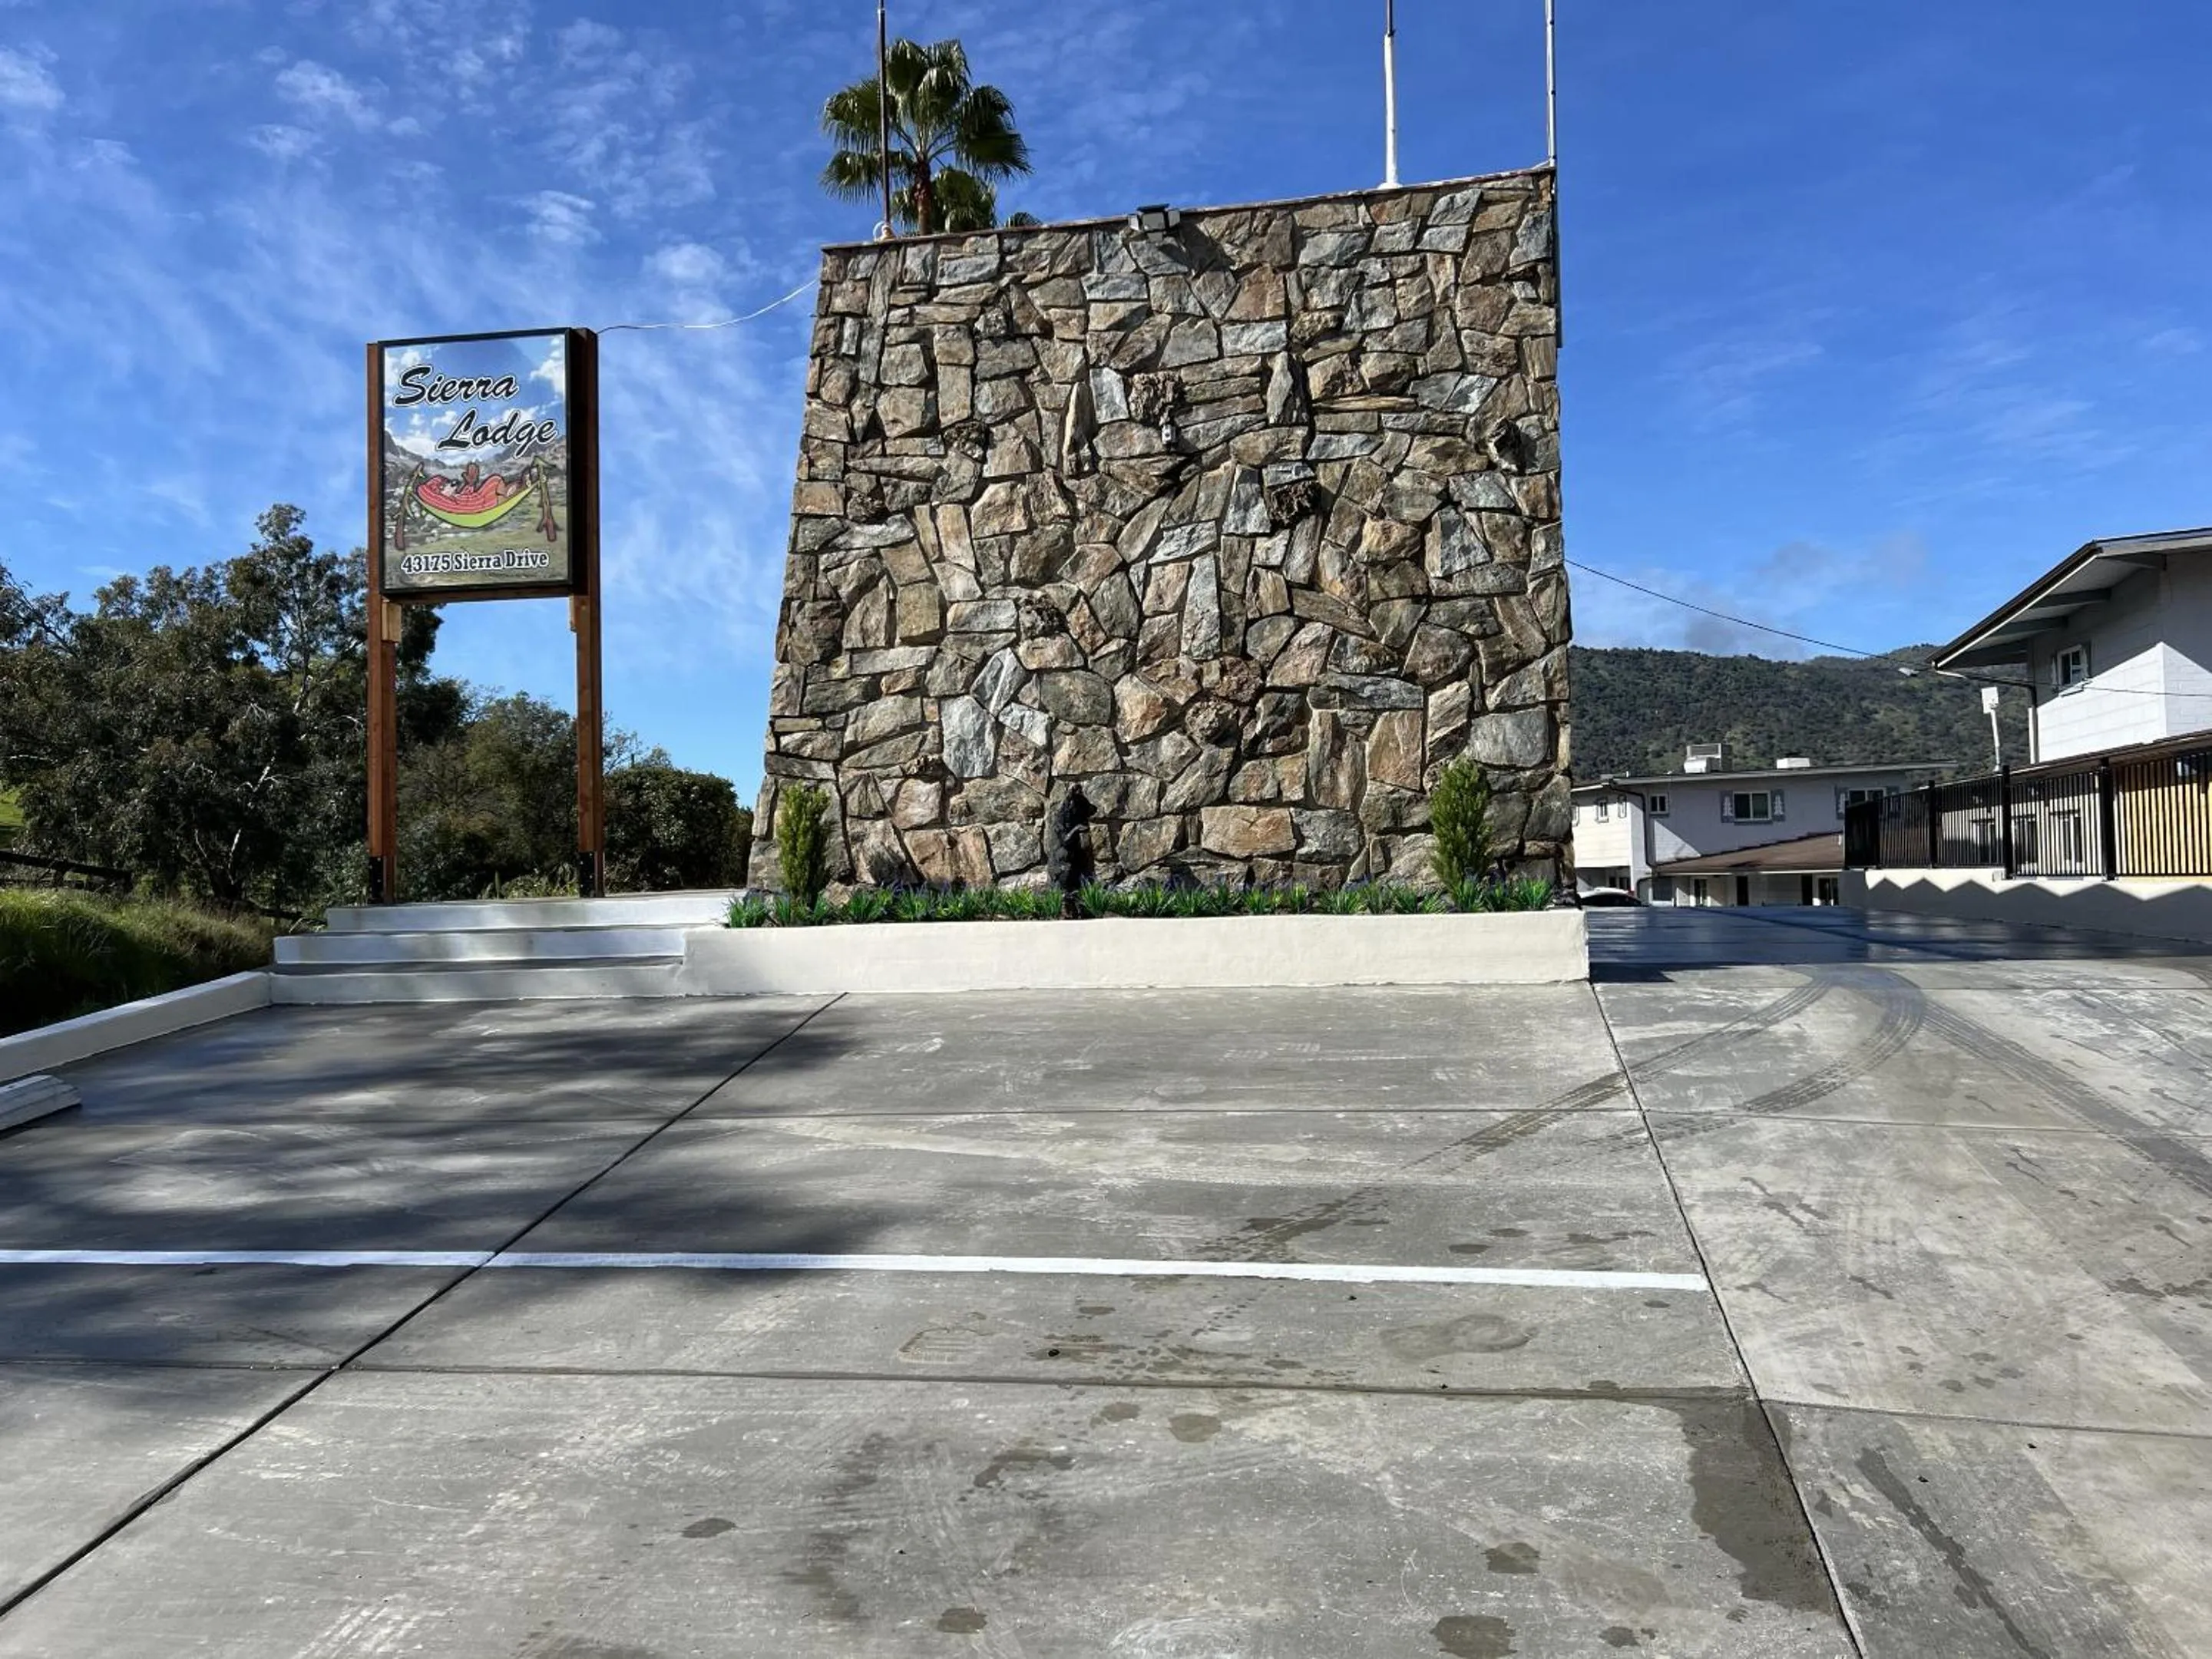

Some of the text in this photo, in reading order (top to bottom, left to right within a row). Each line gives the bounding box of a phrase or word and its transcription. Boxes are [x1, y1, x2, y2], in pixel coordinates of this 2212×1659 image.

[394, 365, 519, 406] Sierra
[438, 409, 557, 457] Lodge
[402, 550, 548, 573] 43175 Sierra Drive
